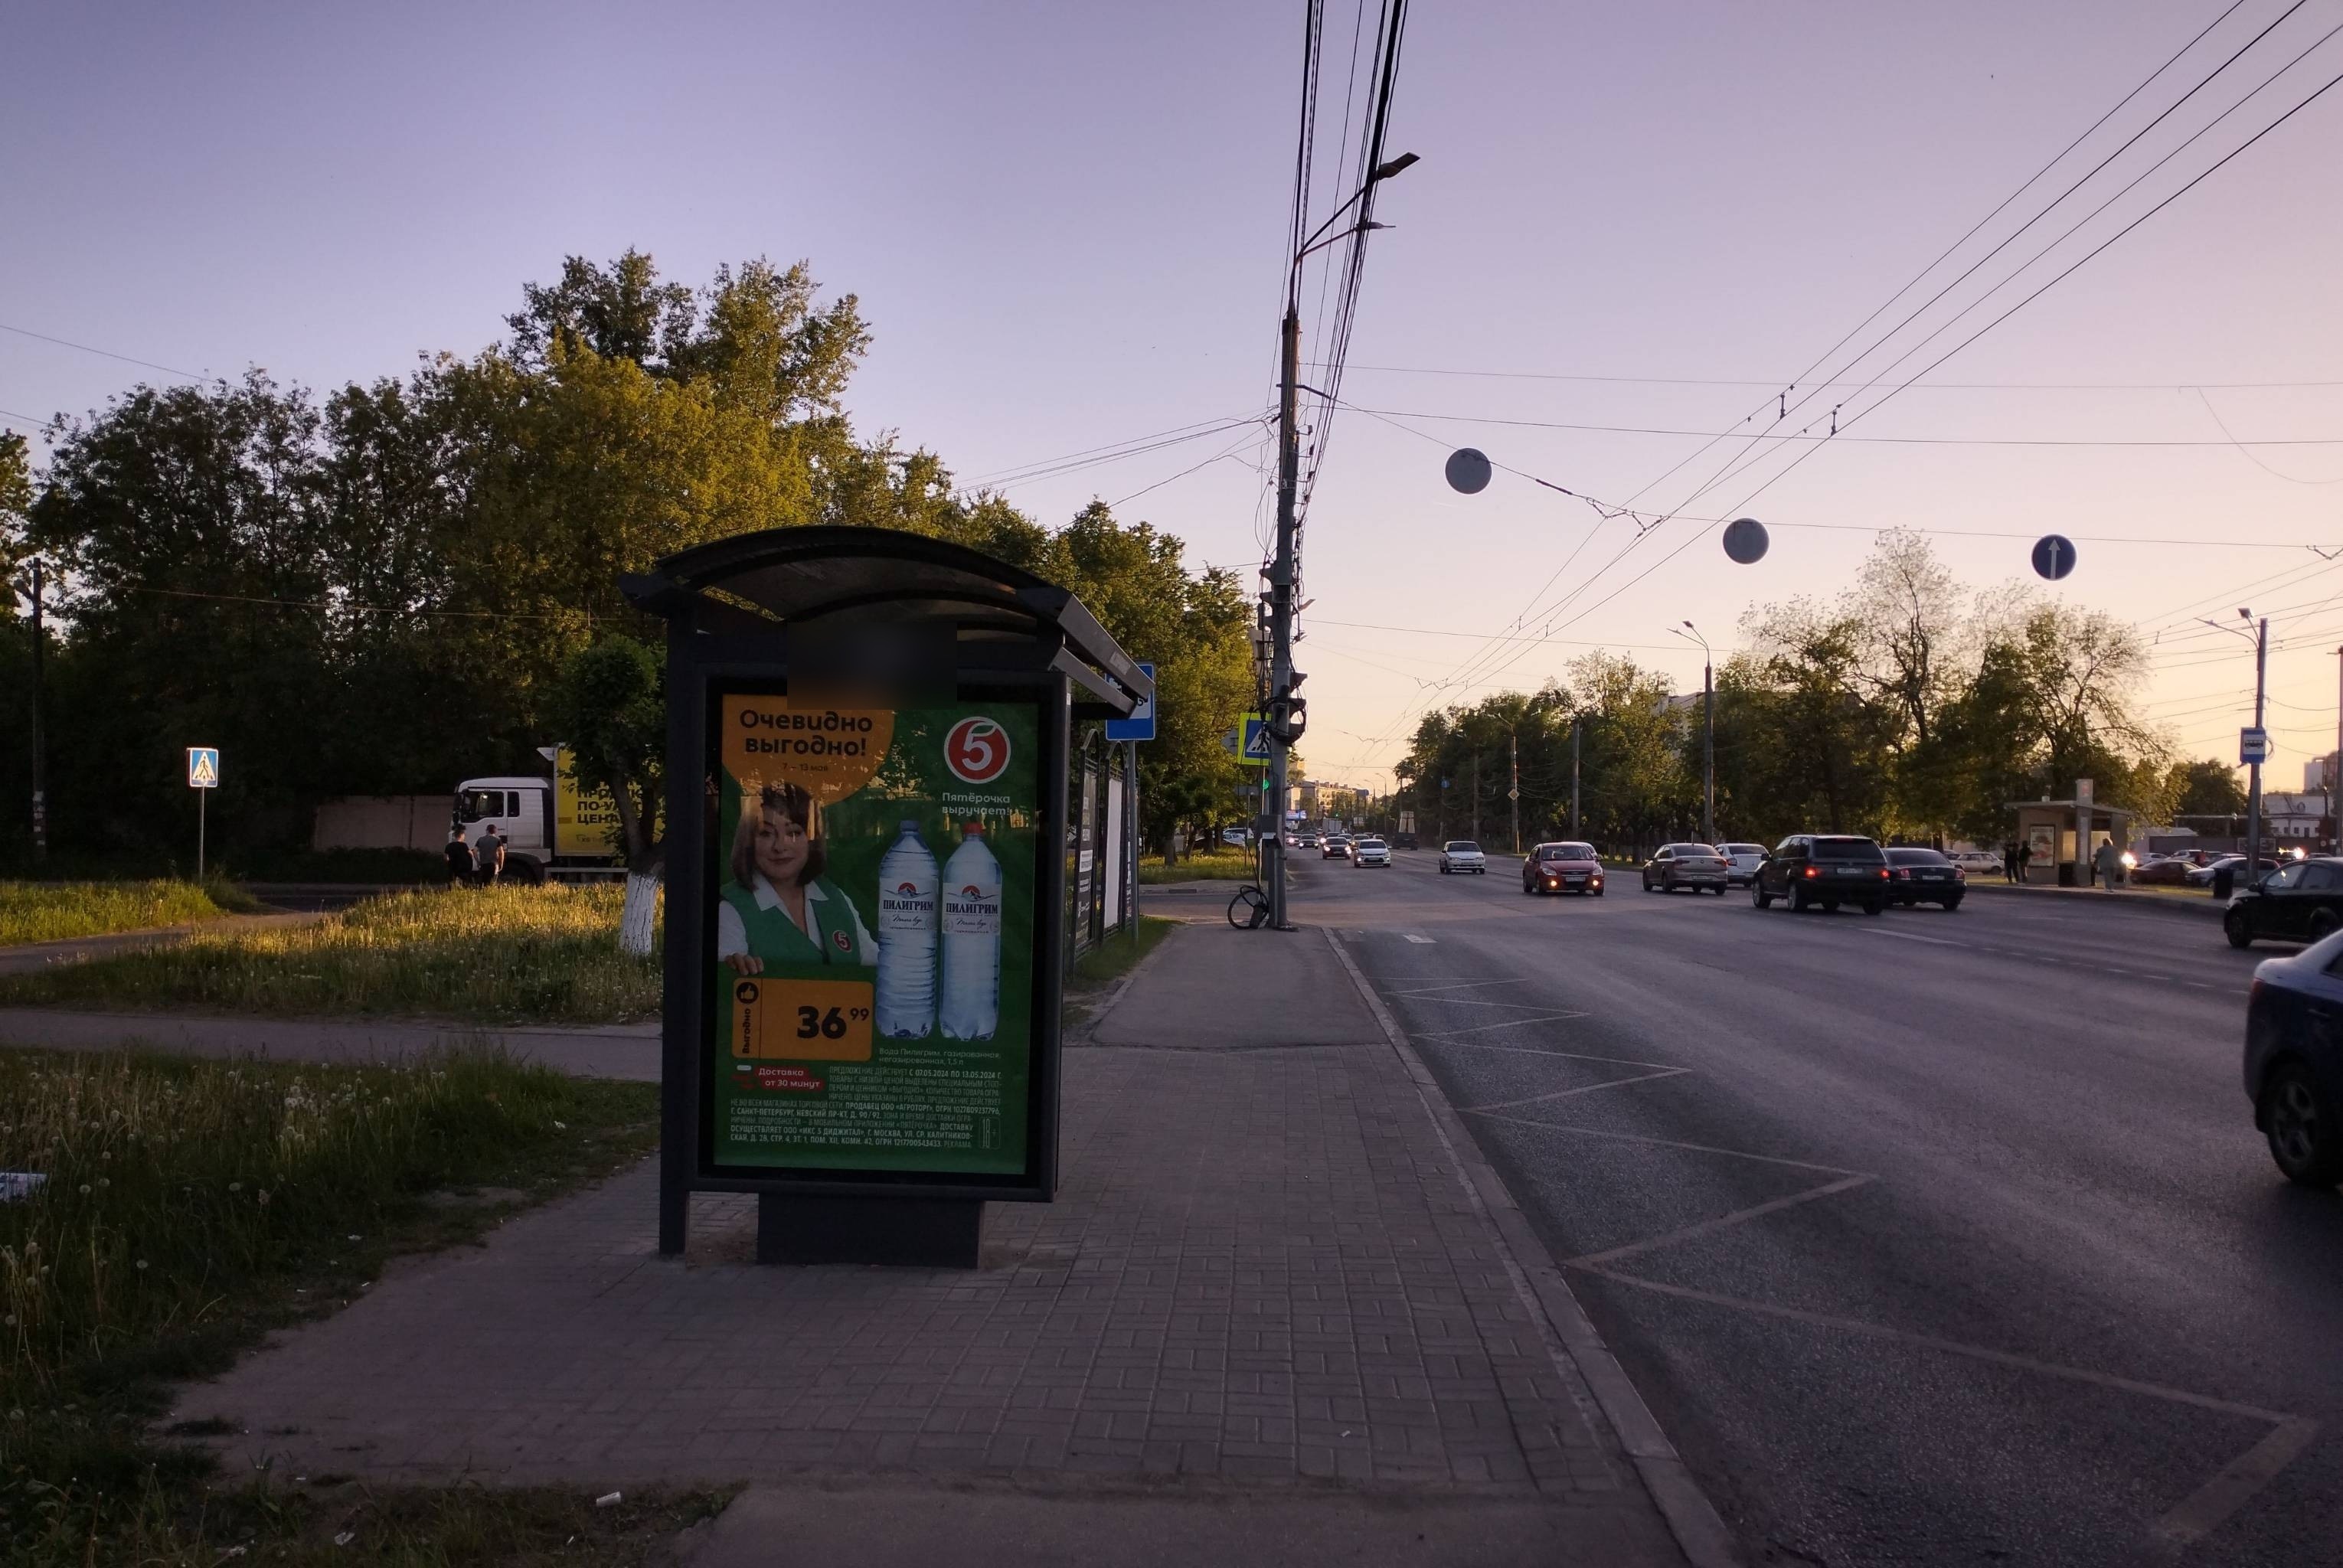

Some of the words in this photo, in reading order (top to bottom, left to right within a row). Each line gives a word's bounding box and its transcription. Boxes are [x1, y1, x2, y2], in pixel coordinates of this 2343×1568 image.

[740, 709, 872, 732] Очевидно
[746, 735, 866, 756] выгодно!
[962, 721, 997, 771] 5
[943, 792, 1010, 804] Пятёрочка
[577, 801, 600, 811] ПО
[942, 806, 1009, 817] выручает!
[577, 814, 621, 825] ЦЕНА
[883, 900, 933, 911] ПИЛИГРИМ
[946, 903, 998, 913] ПИЛИГРИМ
[797, 1005, 847, 1039] 36
[850, 1008, 869, 1021] 99
[879, 1047, 899, 1056] Вода
[759, 1068, 803, 1076] Доставка
[790, 1081, 820, 1089] минут
[730, 1125, 782, 1134] ОСУЩЕСТВЛЯЕТ
[939, 1122, 974, 1131] ДОСТАВКУ
